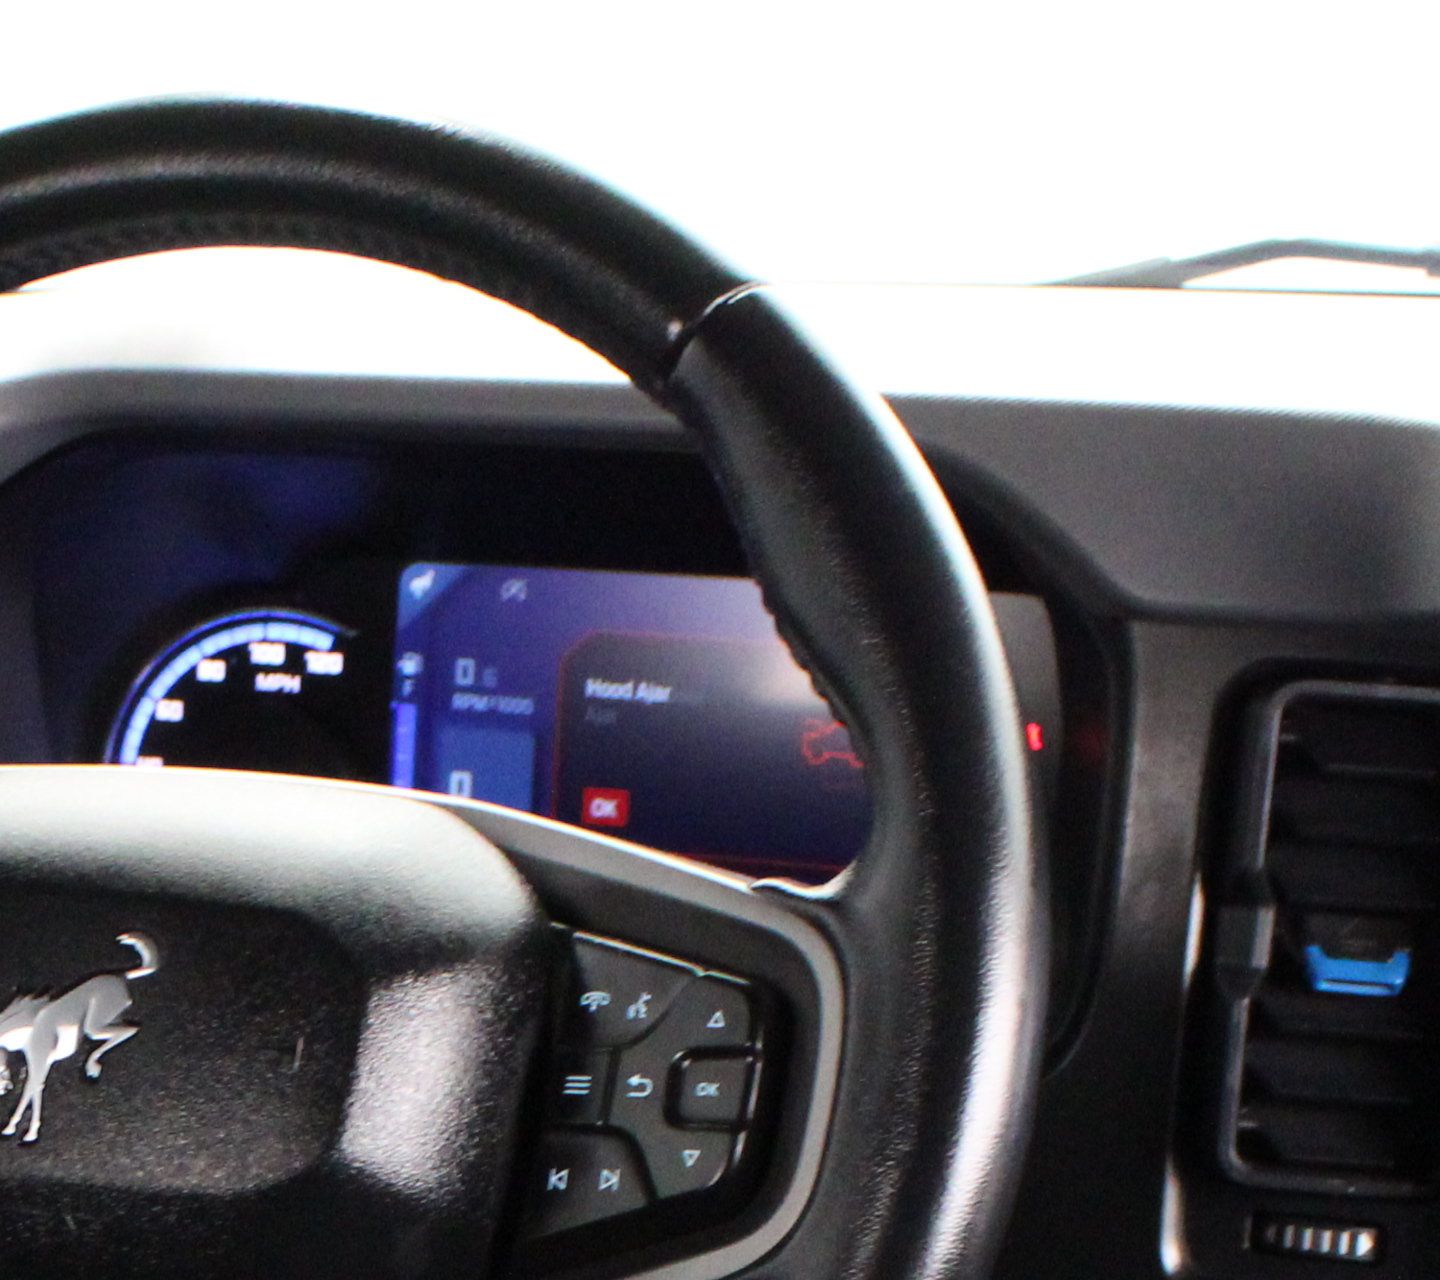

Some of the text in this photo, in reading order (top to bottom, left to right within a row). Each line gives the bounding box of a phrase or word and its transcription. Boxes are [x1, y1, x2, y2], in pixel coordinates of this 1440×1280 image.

[254, 672, 301, 694] MPH
[584, 678, 672, 704] Hood Ajar
[590, 798, 618, 819] OK
